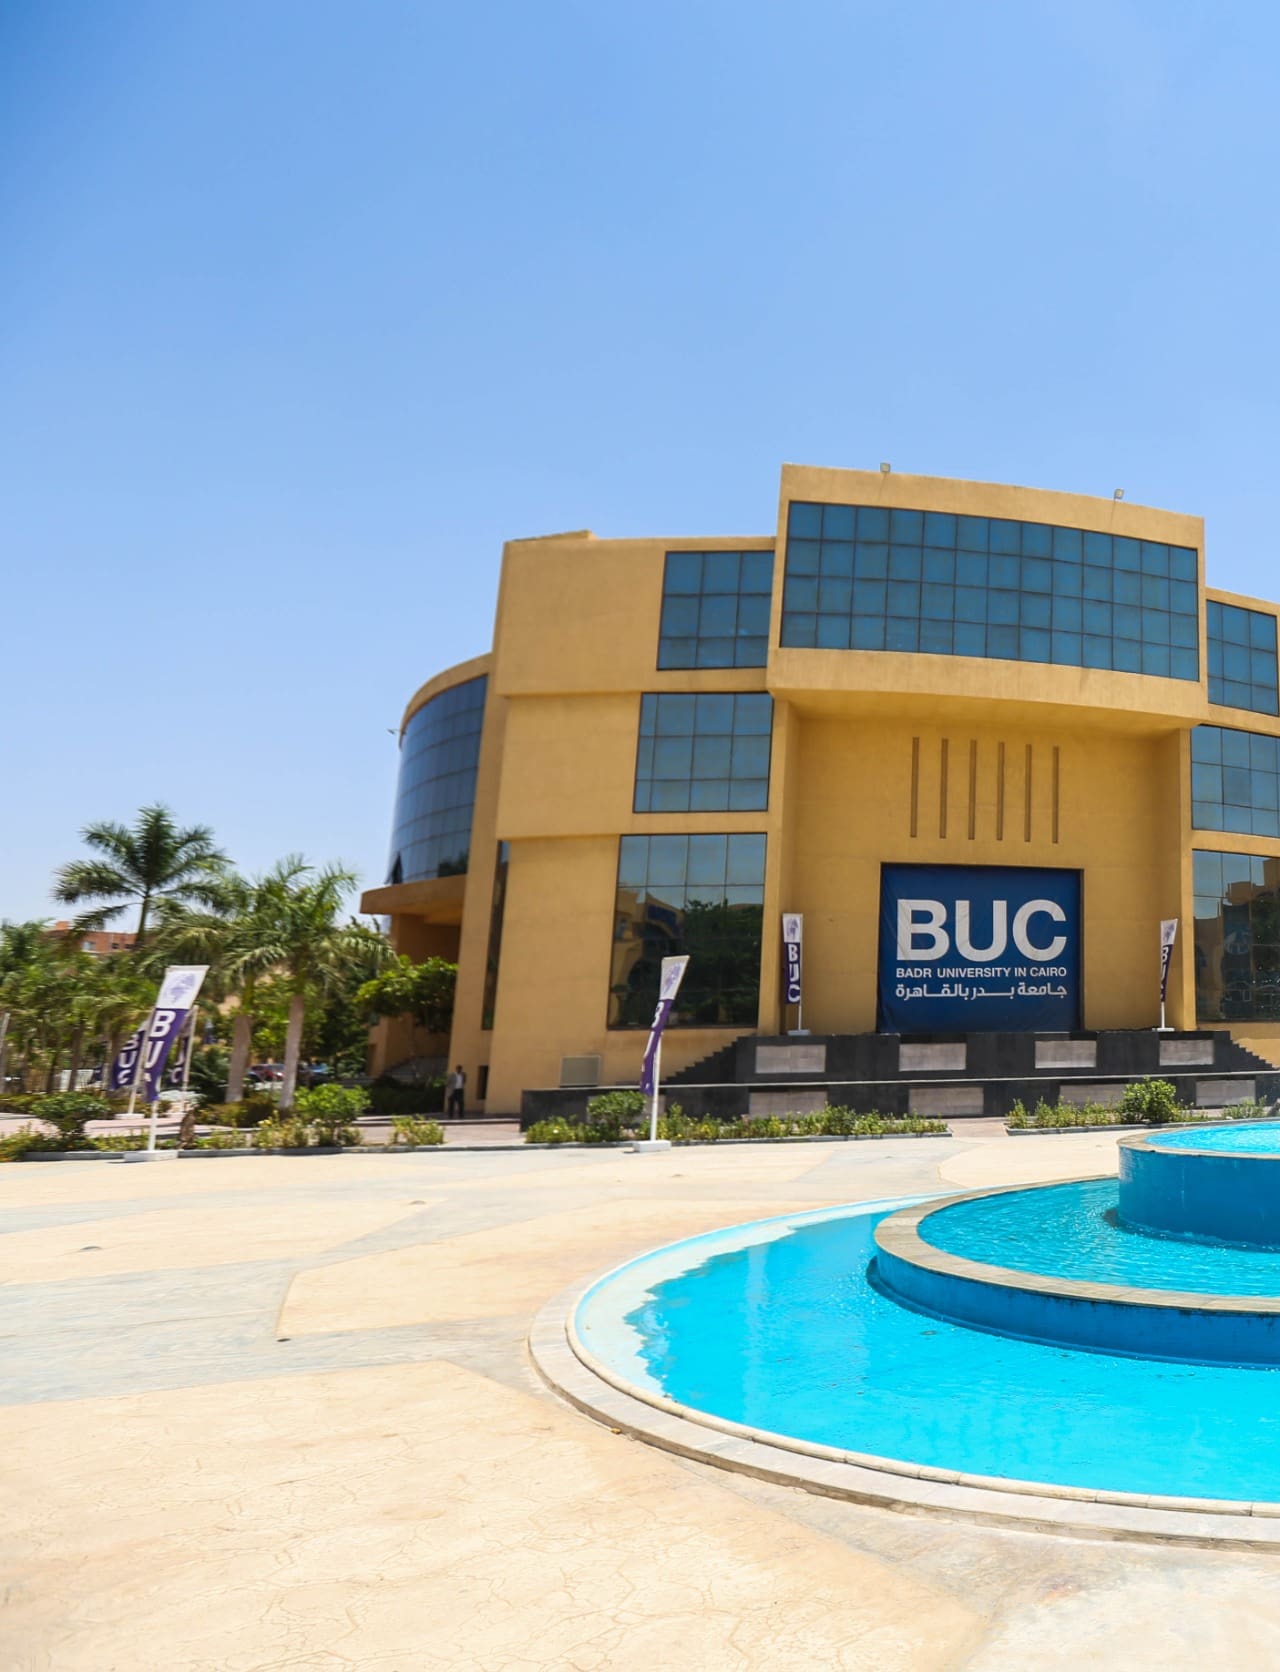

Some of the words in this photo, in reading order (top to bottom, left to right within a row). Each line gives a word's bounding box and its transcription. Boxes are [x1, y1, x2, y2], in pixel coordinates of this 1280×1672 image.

[896, 898, 1067, 962] BUC
[787, 943, 801, 1003] BUC
[895, 967, 932, 979] BADR
[937, 966, 1011, 978] UNIVERSITY
[1014, 966, 1027, 977] IN
[1029, 966, 1067, 977] CAIRO
[1017, 982, 1068, 999] جامعة
